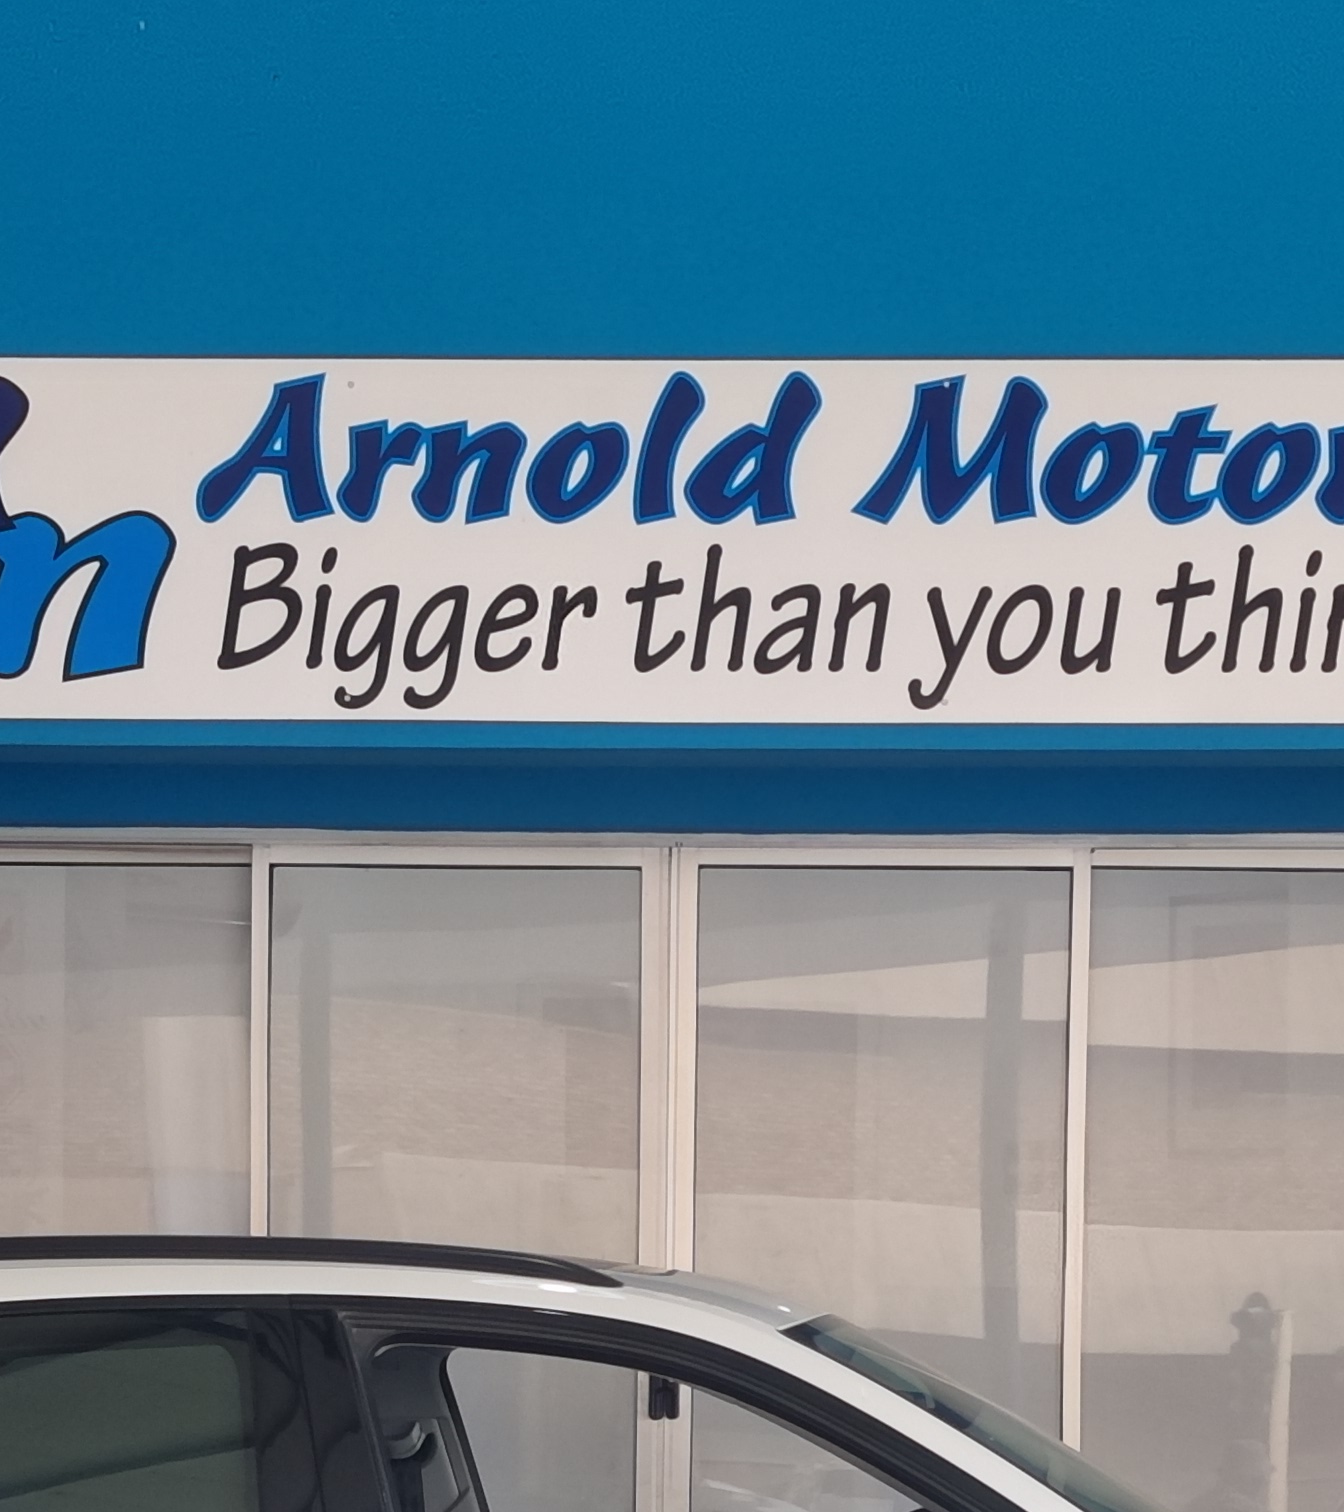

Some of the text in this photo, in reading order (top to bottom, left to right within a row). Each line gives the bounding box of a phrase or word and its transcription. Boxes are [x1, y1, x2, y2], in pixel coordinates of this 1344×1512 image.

[196, 371, 822, 525] Arnold
[217, 542, 597, 709] Bigger
[626, 543, 891, 673] than
[908, 583, 1118, 709] you
